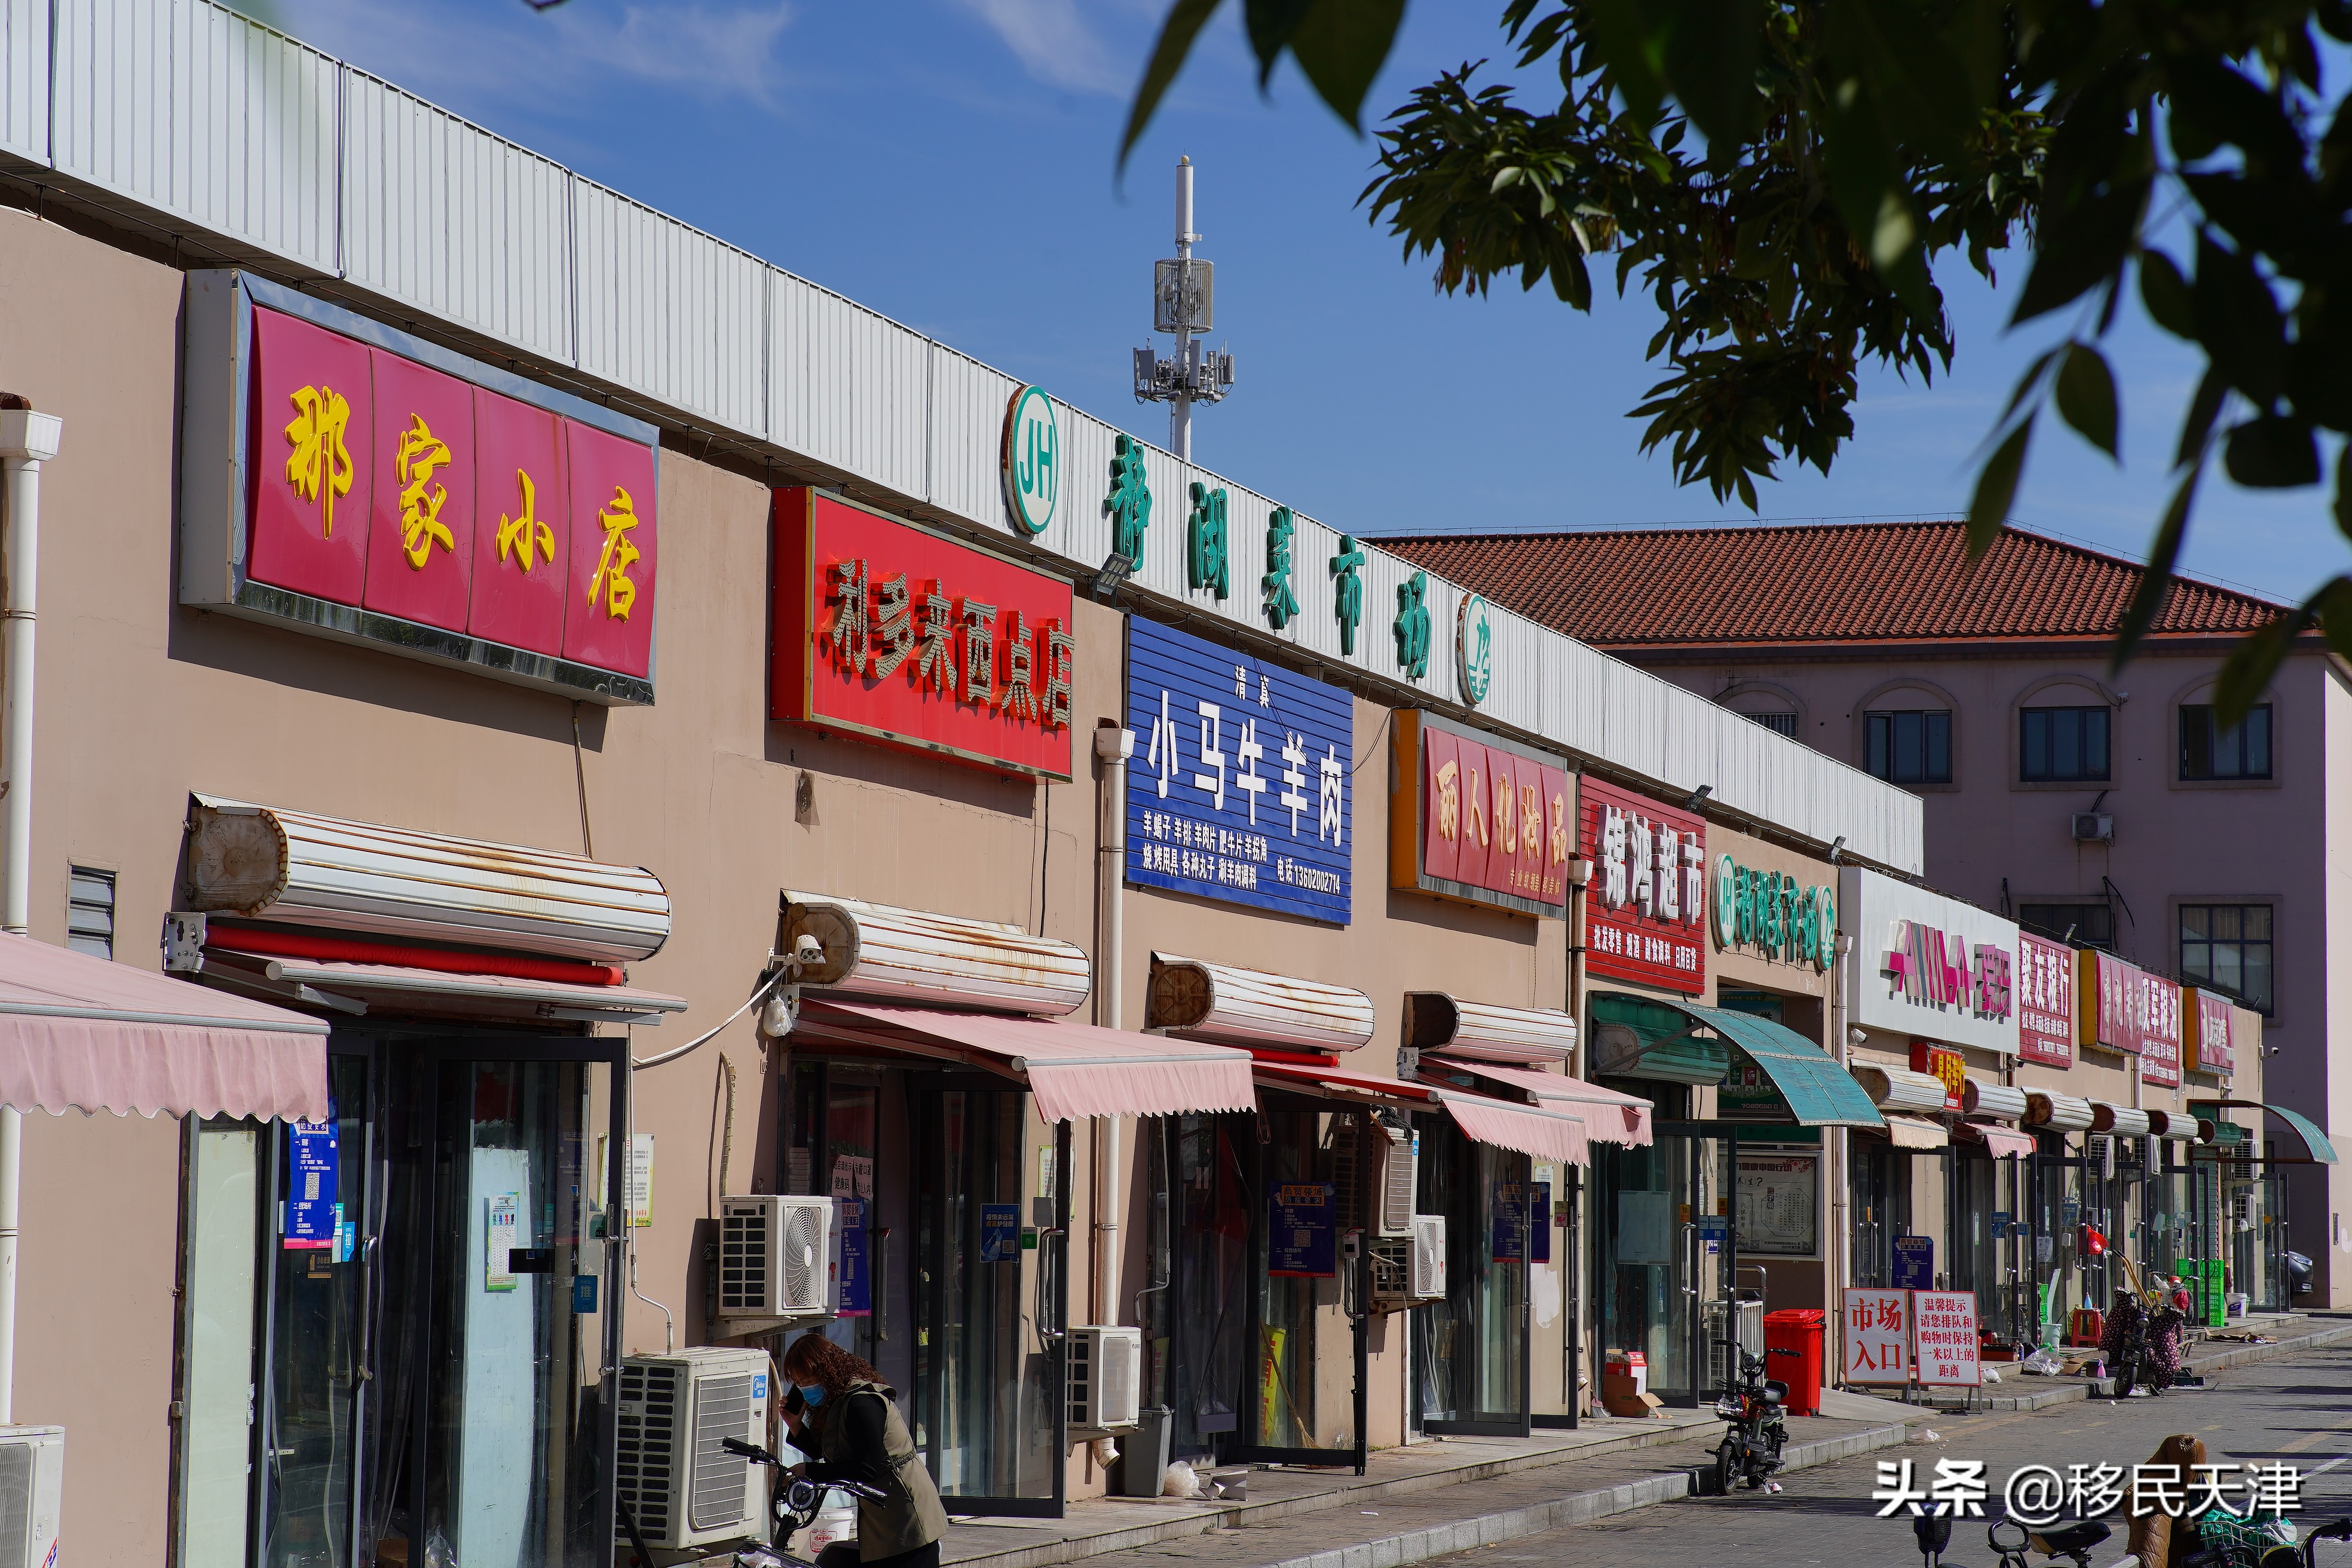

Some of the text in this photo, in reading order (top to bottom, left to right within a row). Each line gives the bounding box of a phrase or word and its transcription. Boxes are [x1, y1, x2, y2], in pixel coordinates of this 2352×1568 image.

[1019, 417, 1053, 503] JH
[822, 559, 1075, 730] 利多来西点店
[1235, 664, 1269, 709] 清真
[1147, 690, 1342, 847] 小马牛羊肉
[1143, 810, 1172, 841] 羊蝎子
[1174, 819, 1192, 846] 羊排
[1194, 823, 1217, 852] 羊肉片
[1435, 760, 1567, 868] 丽人化妆品
[1143, 843, 1257, 890] 烧烤用具 各种丸子 涮羊肉调料
[1276, 856, 1340, 893] 电话 13602002714
[1721, 877, 1732, 926] JH
[1594, 924, 1696, 971] 批发零售 烟酒 副食调料 日用百货
[2020, 941, 2069, 1016] 聚友粮行
[835, 1176, 849, 1191] 健康码
[1284, 1186, 1323, 1196] 商贸领域
[580, 1285, 592, 1297] 推
[1925, 1298, 1966, 1310] 温馨提示
[1849, 1297, 1902, 1332] 市场
[1921, 1315, 1973, 1329] 请您排队和
[1852, 1340, 1901, 1371] 入口
[1921, 1331, 1974, 1346] 购物时保持
[1922, 1348, 1974, 1362] 一米以上的
[1939, 1364, 1959, 1378] 距离
